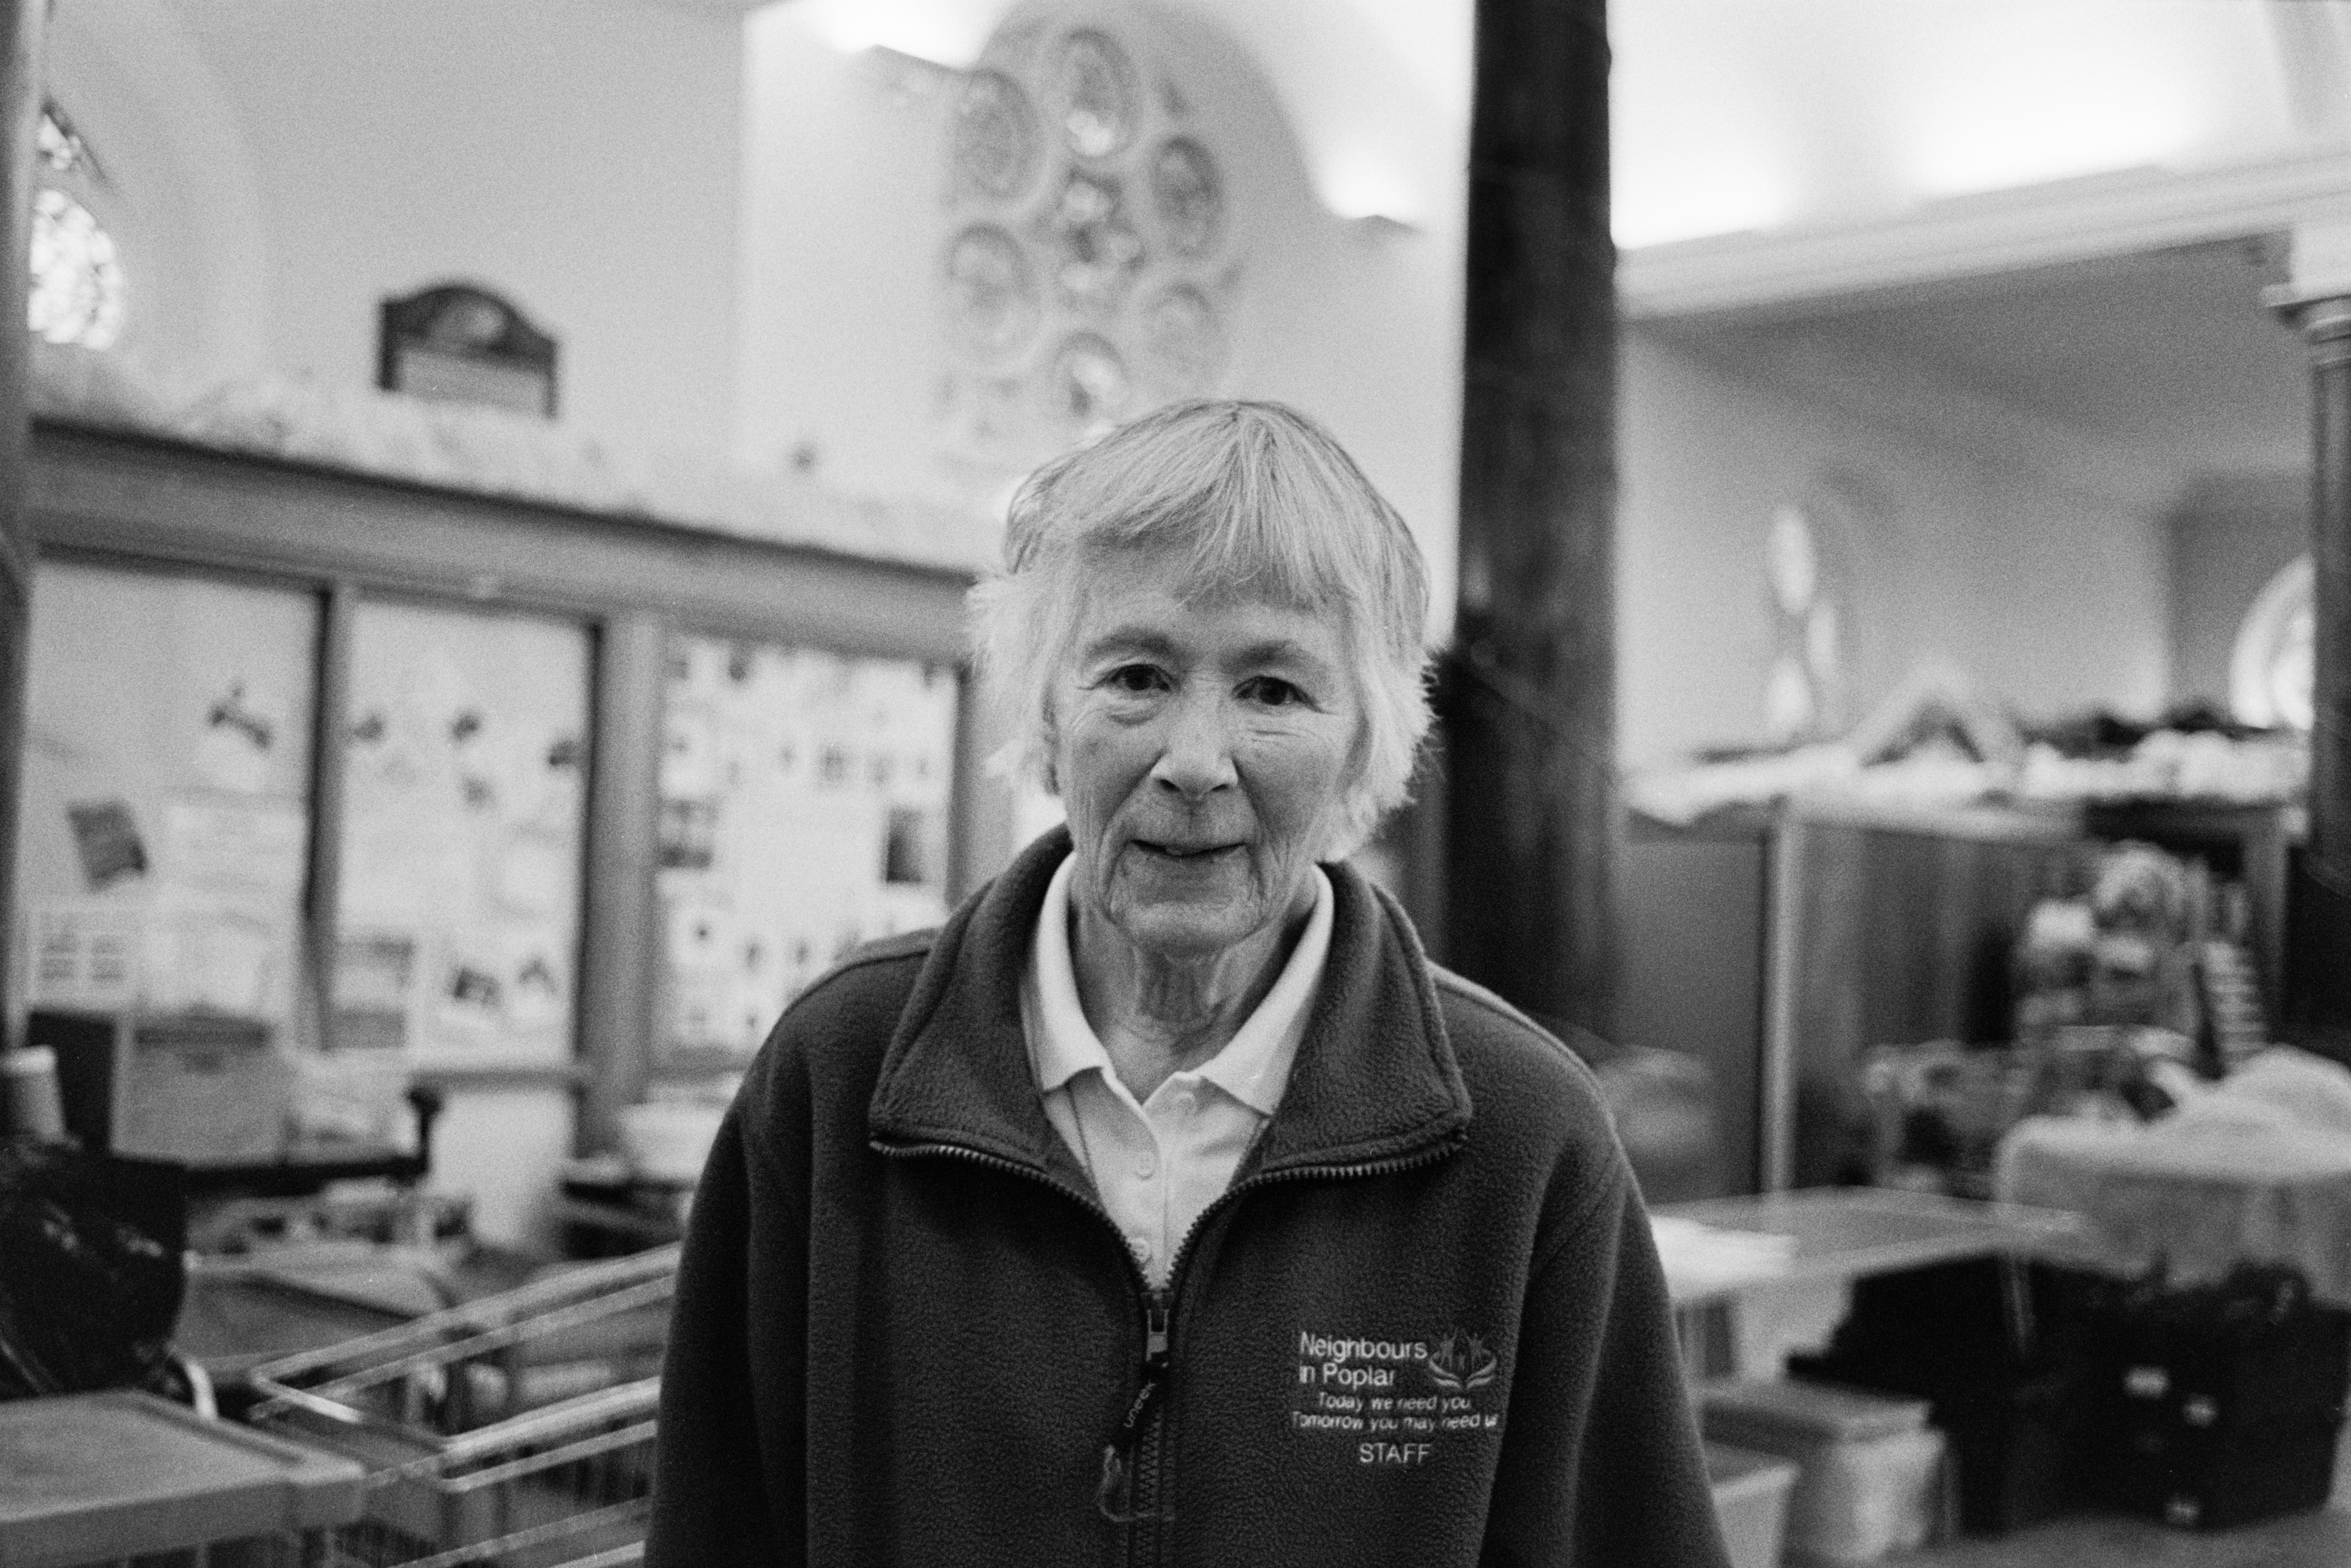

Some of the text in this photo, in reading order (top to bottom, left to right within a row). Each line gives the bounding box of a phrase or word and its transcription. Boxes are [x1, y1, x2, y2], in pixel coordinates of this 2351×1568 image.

[1301, 1331, 1428, 1363] Neighbours
[1299, 1362, 1396, 1391] in Poplar
[1318, 1392, 1471, 1413] Today we need you
[1291, 1411, 1364, 1429] Tomorrow
[1370, 1418, 1398, 1432] you
[1404, 1417, 1435, 1432] may
[1442, 1414, 1480, 1429] need
[1359, 1442, 1431, 1464] STAFF
